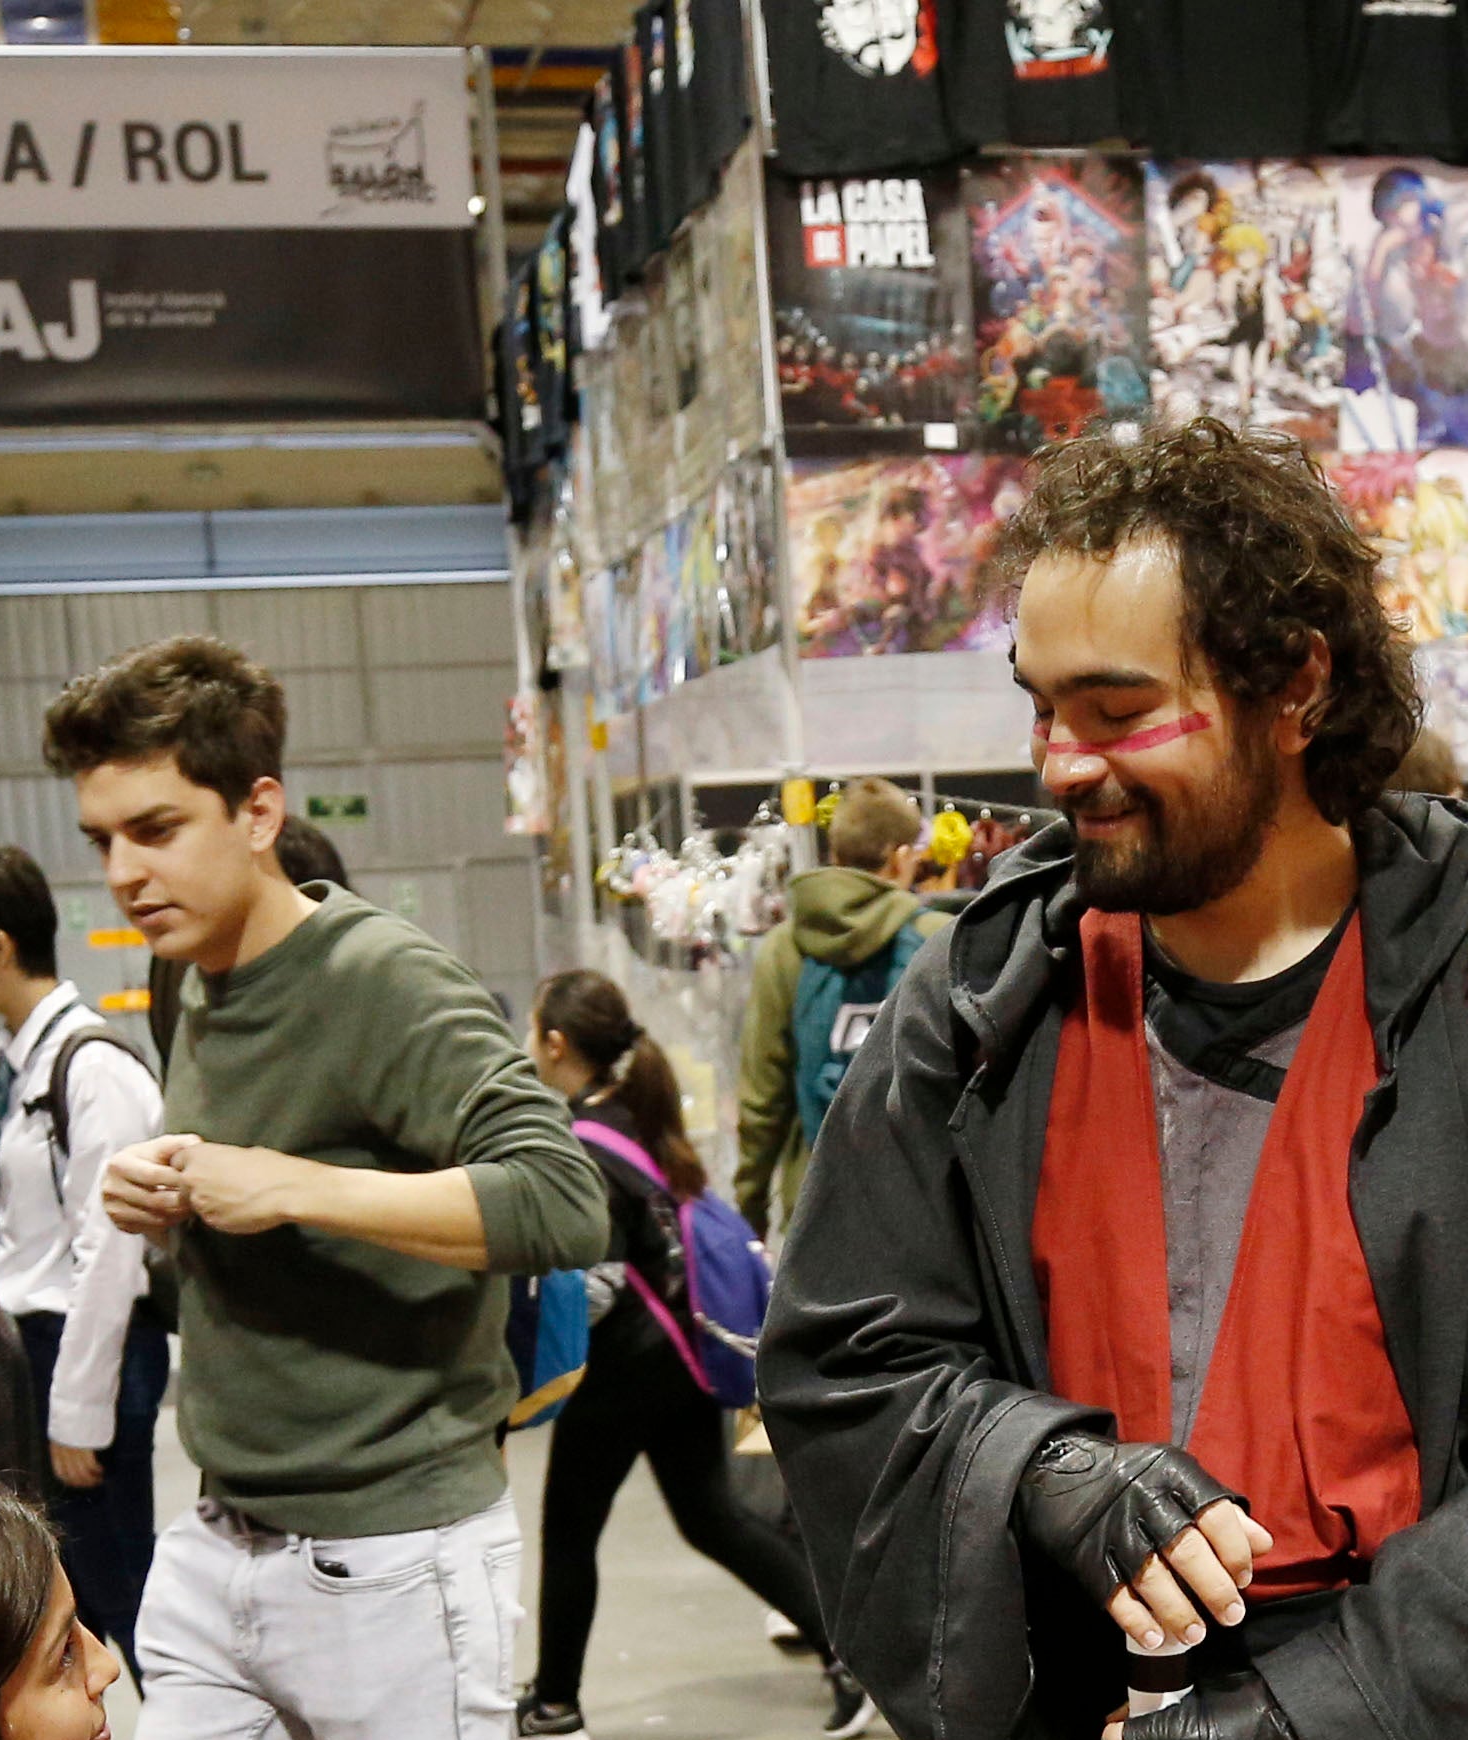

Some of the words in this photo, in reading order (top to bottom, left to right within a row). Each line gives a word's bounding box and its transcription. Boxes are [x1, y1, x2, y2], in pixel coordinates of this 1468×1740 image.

[72, 120, 97, 188] /
[123, 120, 269, 184] ROL
[799, 180, 842, 224] LA
[841, 178, 928, 221] CASA
[812, 229, 841, 262] DE
[845, 222, 936, 269] PAPEL
